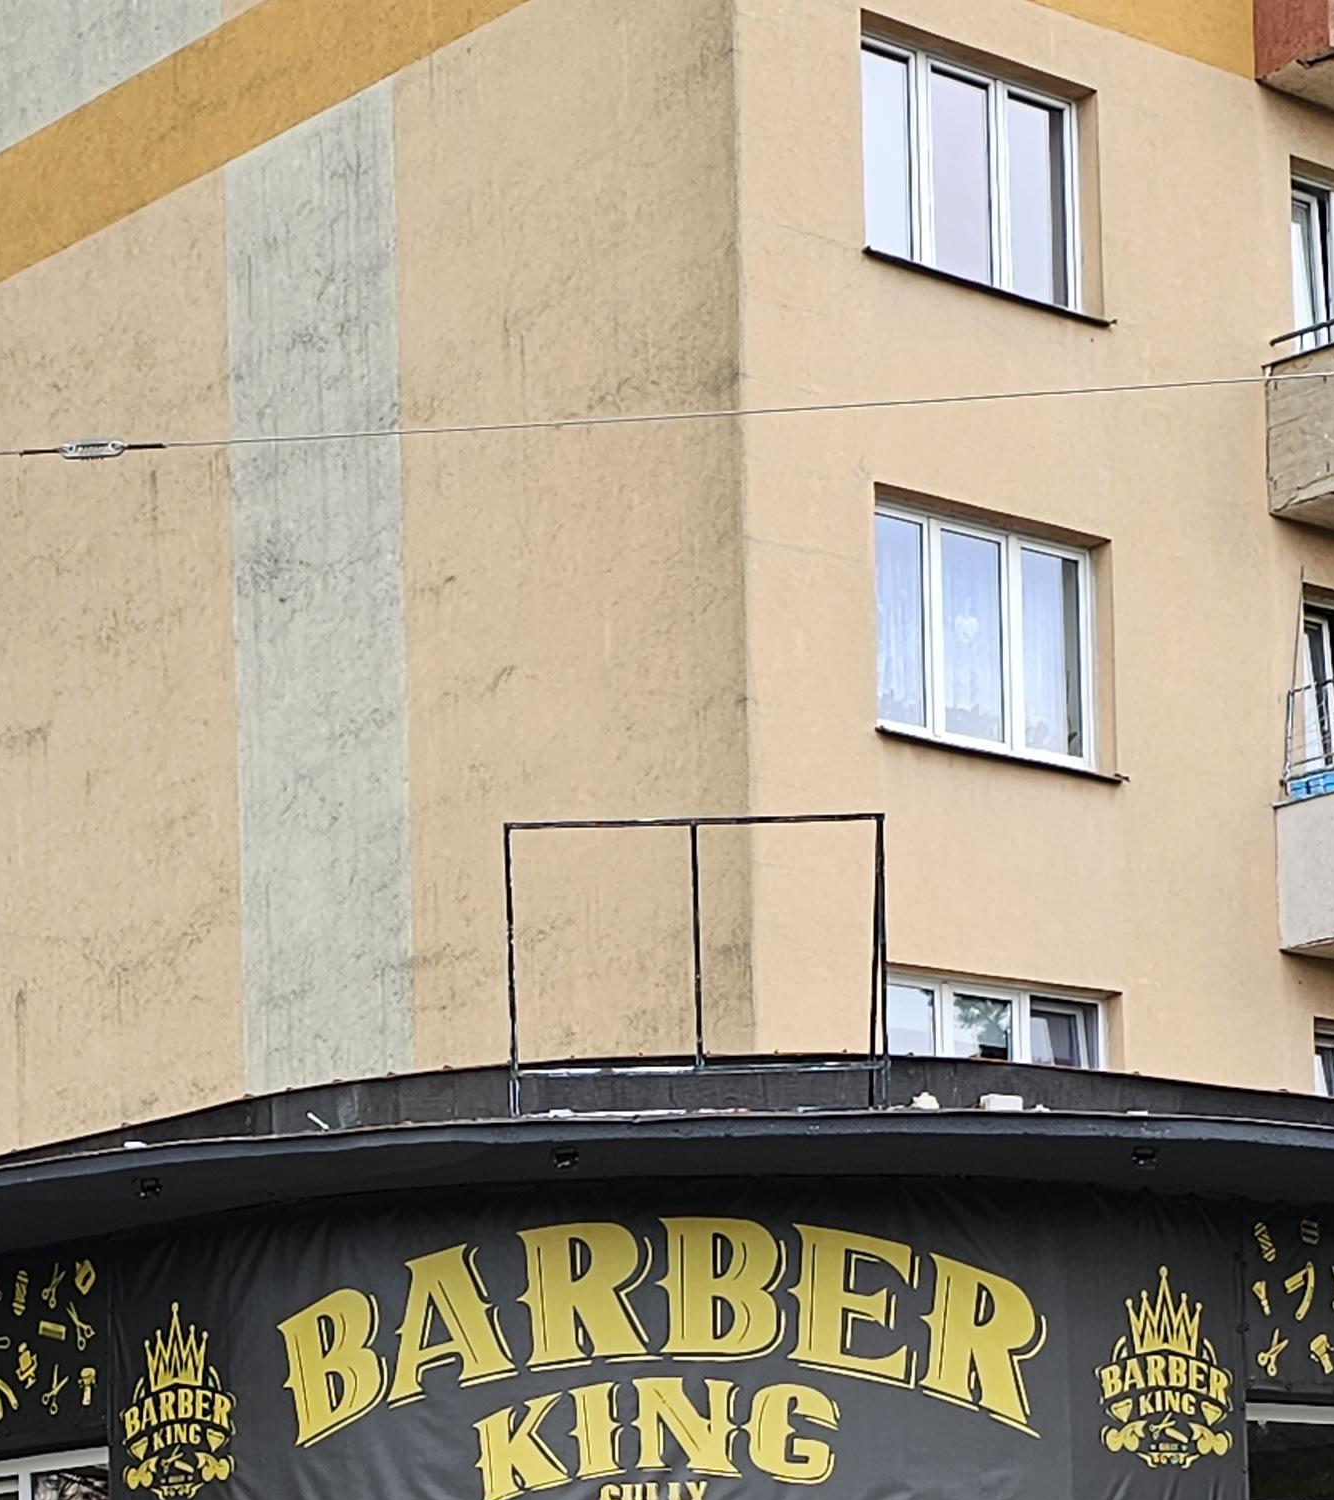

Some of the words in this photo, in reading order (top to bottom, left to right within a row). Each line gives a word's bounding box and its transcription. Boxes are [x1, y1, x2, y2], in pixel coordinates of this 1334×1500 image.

[277, 1217, 1041, 1448] BARBER
[1100, 1355, 1228, 1405] BARBER
[1139, 1390, 1196, 1416] KING
[124, 1388, 231, 1439] BARBER
[153, 1423, 201, 1452] KING
